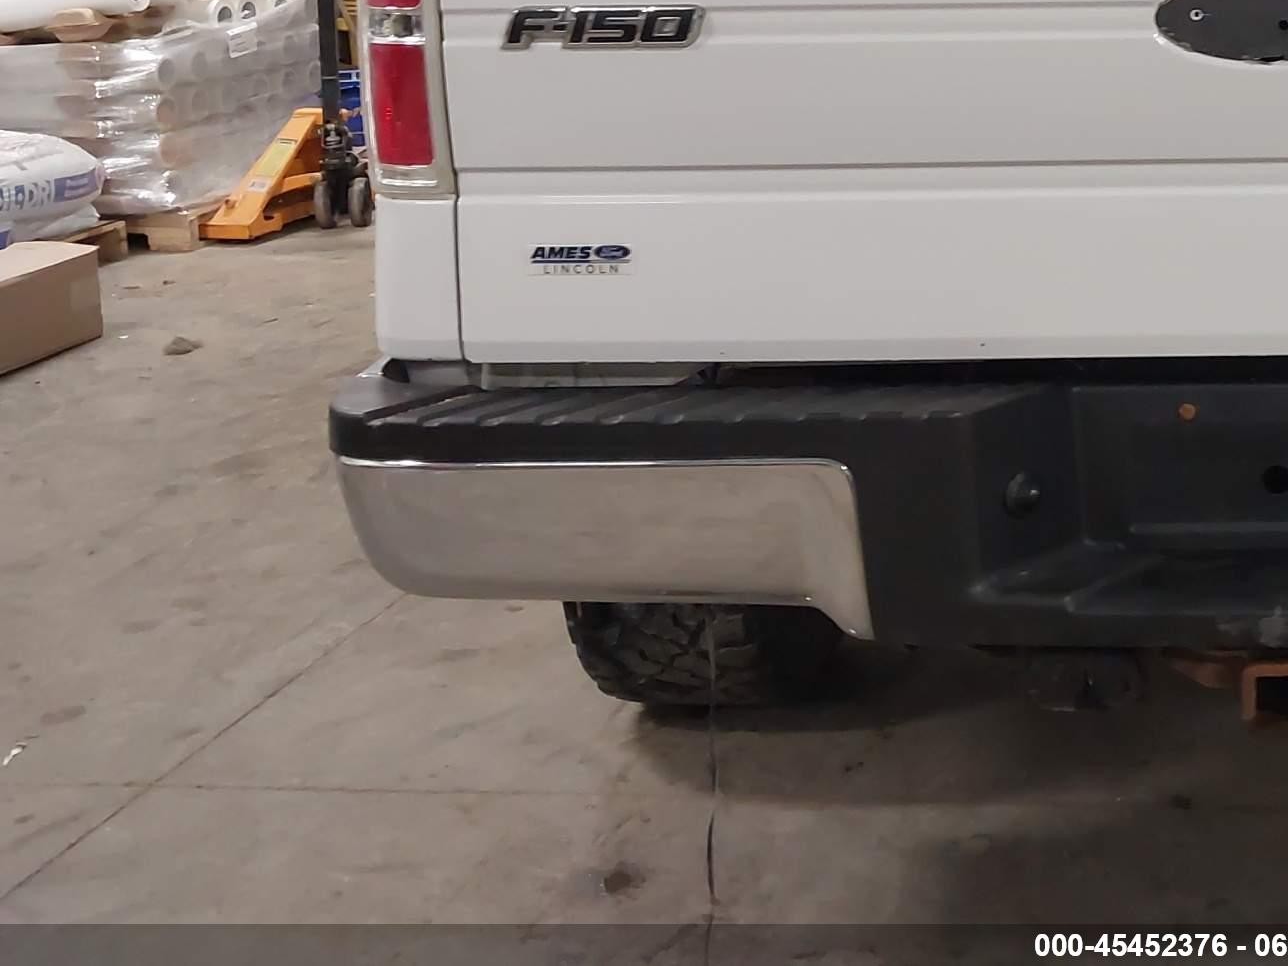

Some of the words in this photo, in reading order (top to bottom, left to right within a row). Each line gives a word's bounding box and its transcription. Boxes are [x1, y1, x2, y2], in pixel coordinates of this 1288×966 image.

[502, 5, 703, 48] F-150
[530, 245, 593, 259] AMES
[543, 264, 618, 274] LINCOLN
